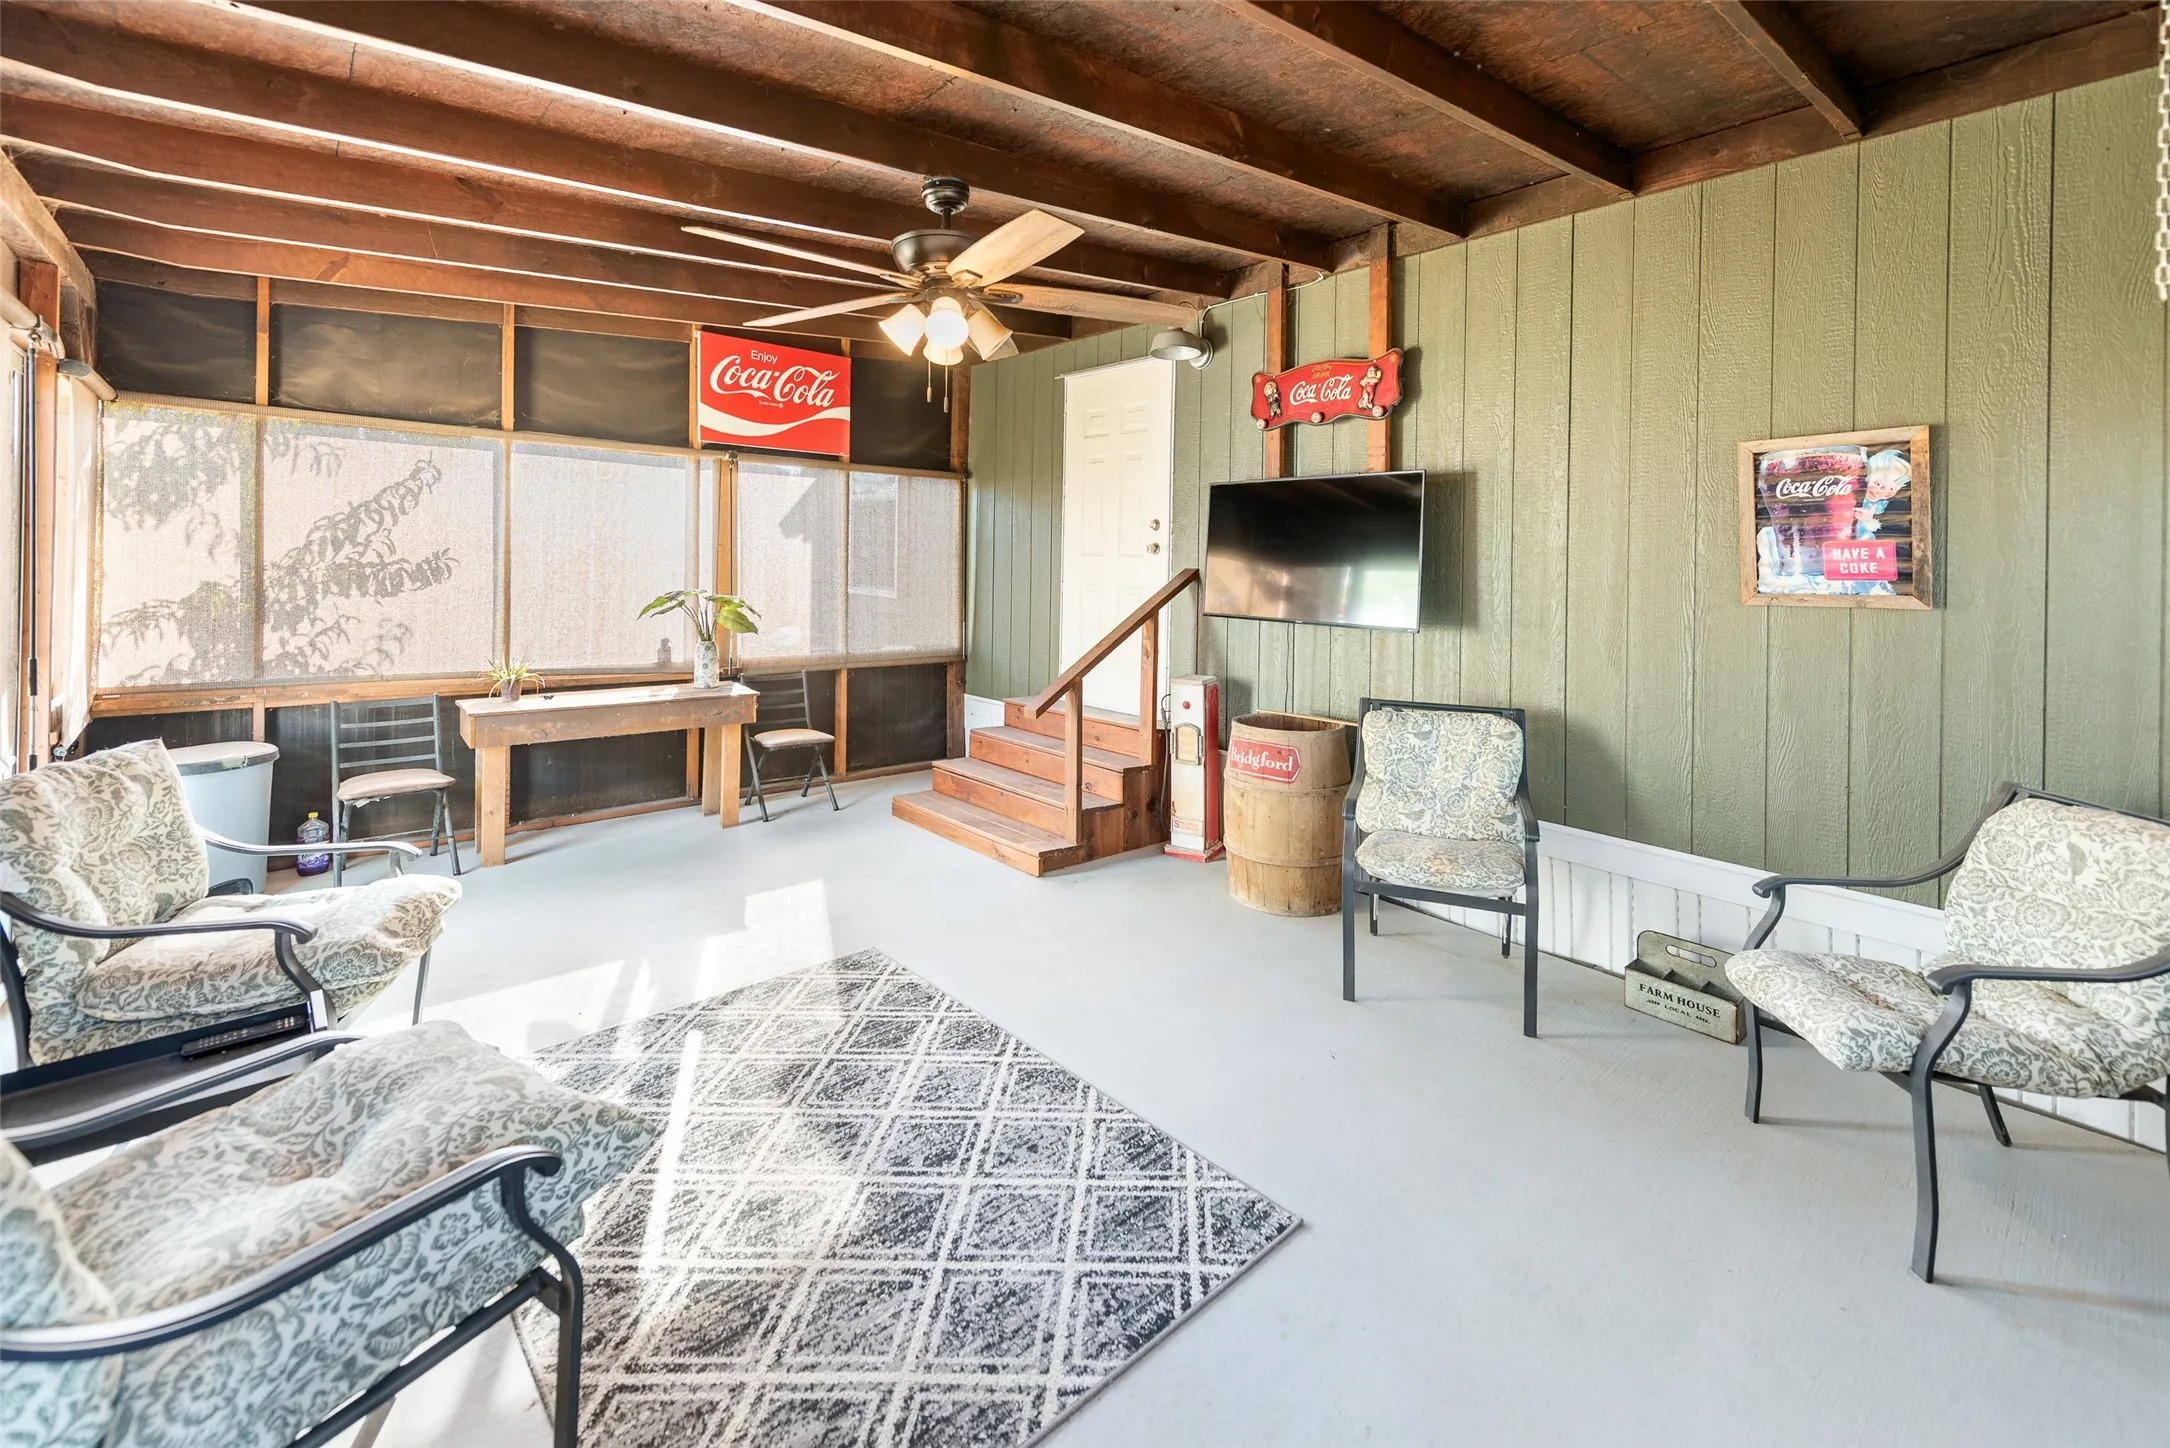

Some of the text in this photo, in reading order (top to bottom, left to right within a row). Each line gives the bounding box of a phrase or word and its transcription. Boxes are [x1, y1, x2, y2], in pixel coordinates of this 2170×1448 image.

[751, 349, 778, 365] Enjoy
[709, 355, 840, 408] Coca-Cola
[1776, 474, 1857, 499] Coca-Cola
[1832, 546, 1886, 560] HAVE A
[1840, 561, 1878, 574] COKE
[1230, 746, 1294, 772] Bridgford
[1639, 983, 1721, 1019] FARM HOUSE
[1664, 1004, 1692, 1018] LOCAL
